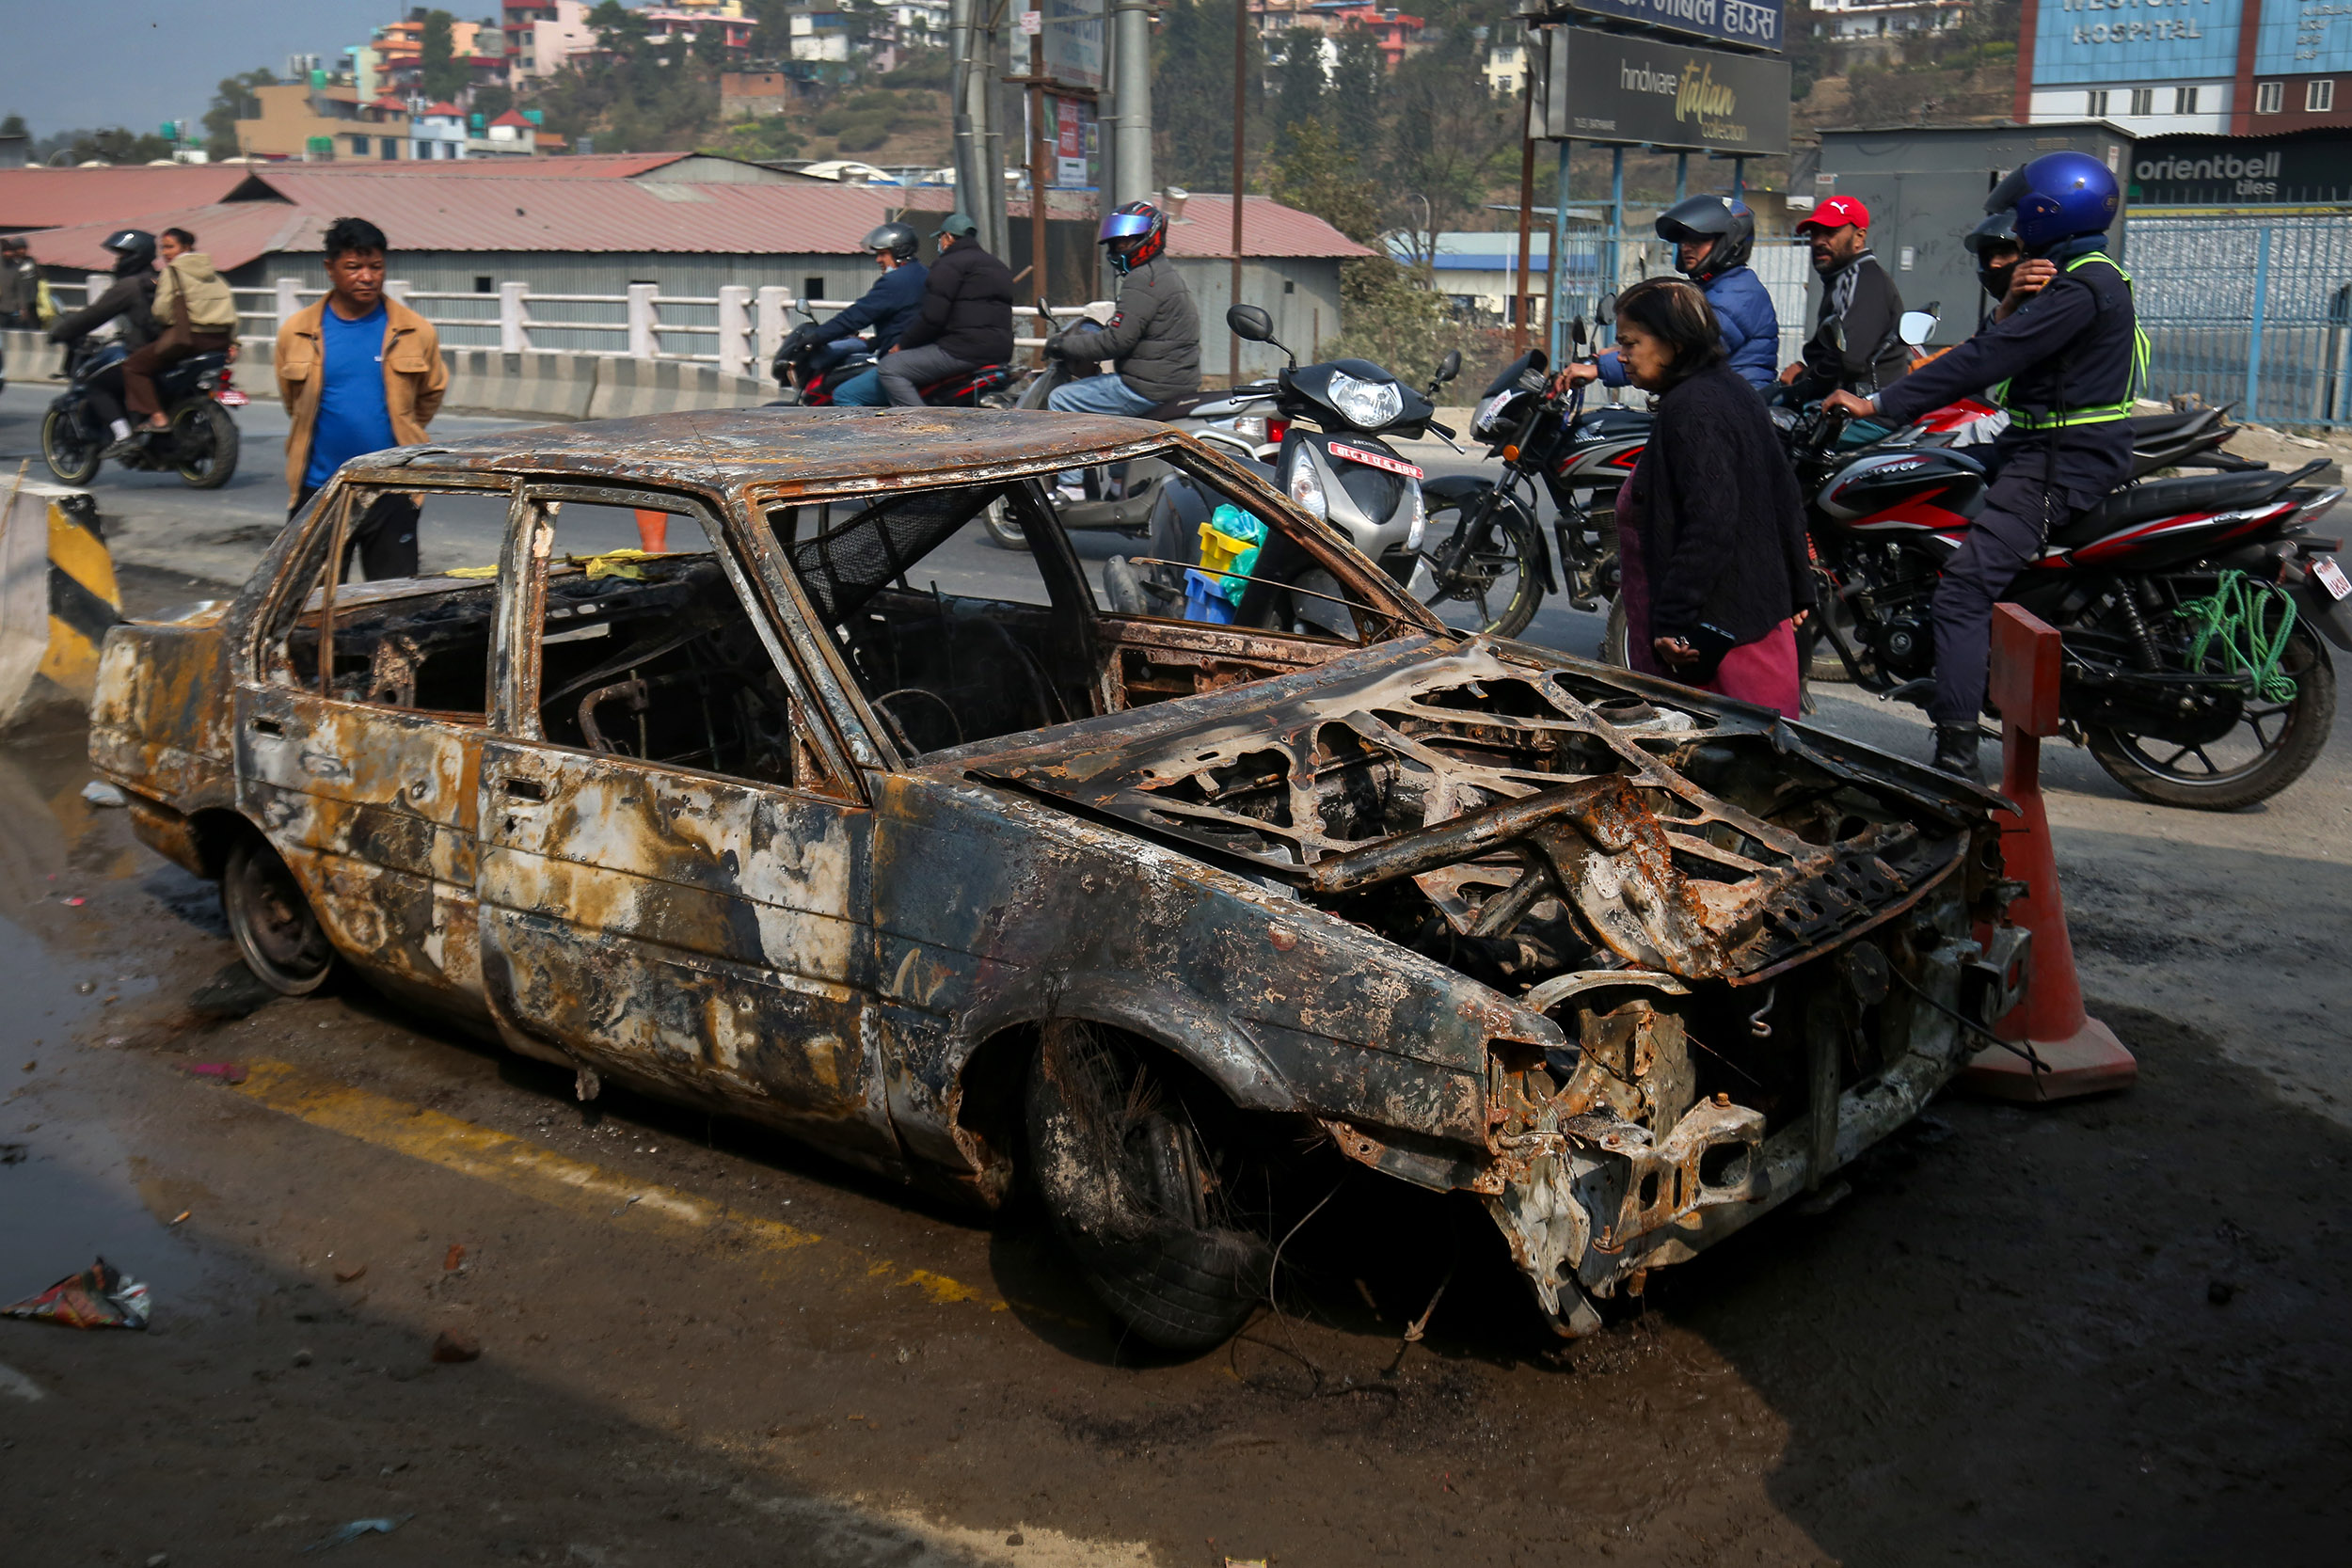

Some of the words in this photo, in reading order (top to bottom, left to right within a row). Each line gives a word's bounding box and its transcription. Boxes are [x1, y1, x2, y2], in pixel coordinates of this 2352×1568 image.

[1723, 0, 1776, 40] हाउस
[2073, 18, 2201, 44] HOSPITAL
[1620, 58, 1677, 95] hindware
[1701, 120, 1747, 142] collection
[2136, 151, 2281, 181] orientbell
[2235, 180, 2279, 196] tiles
